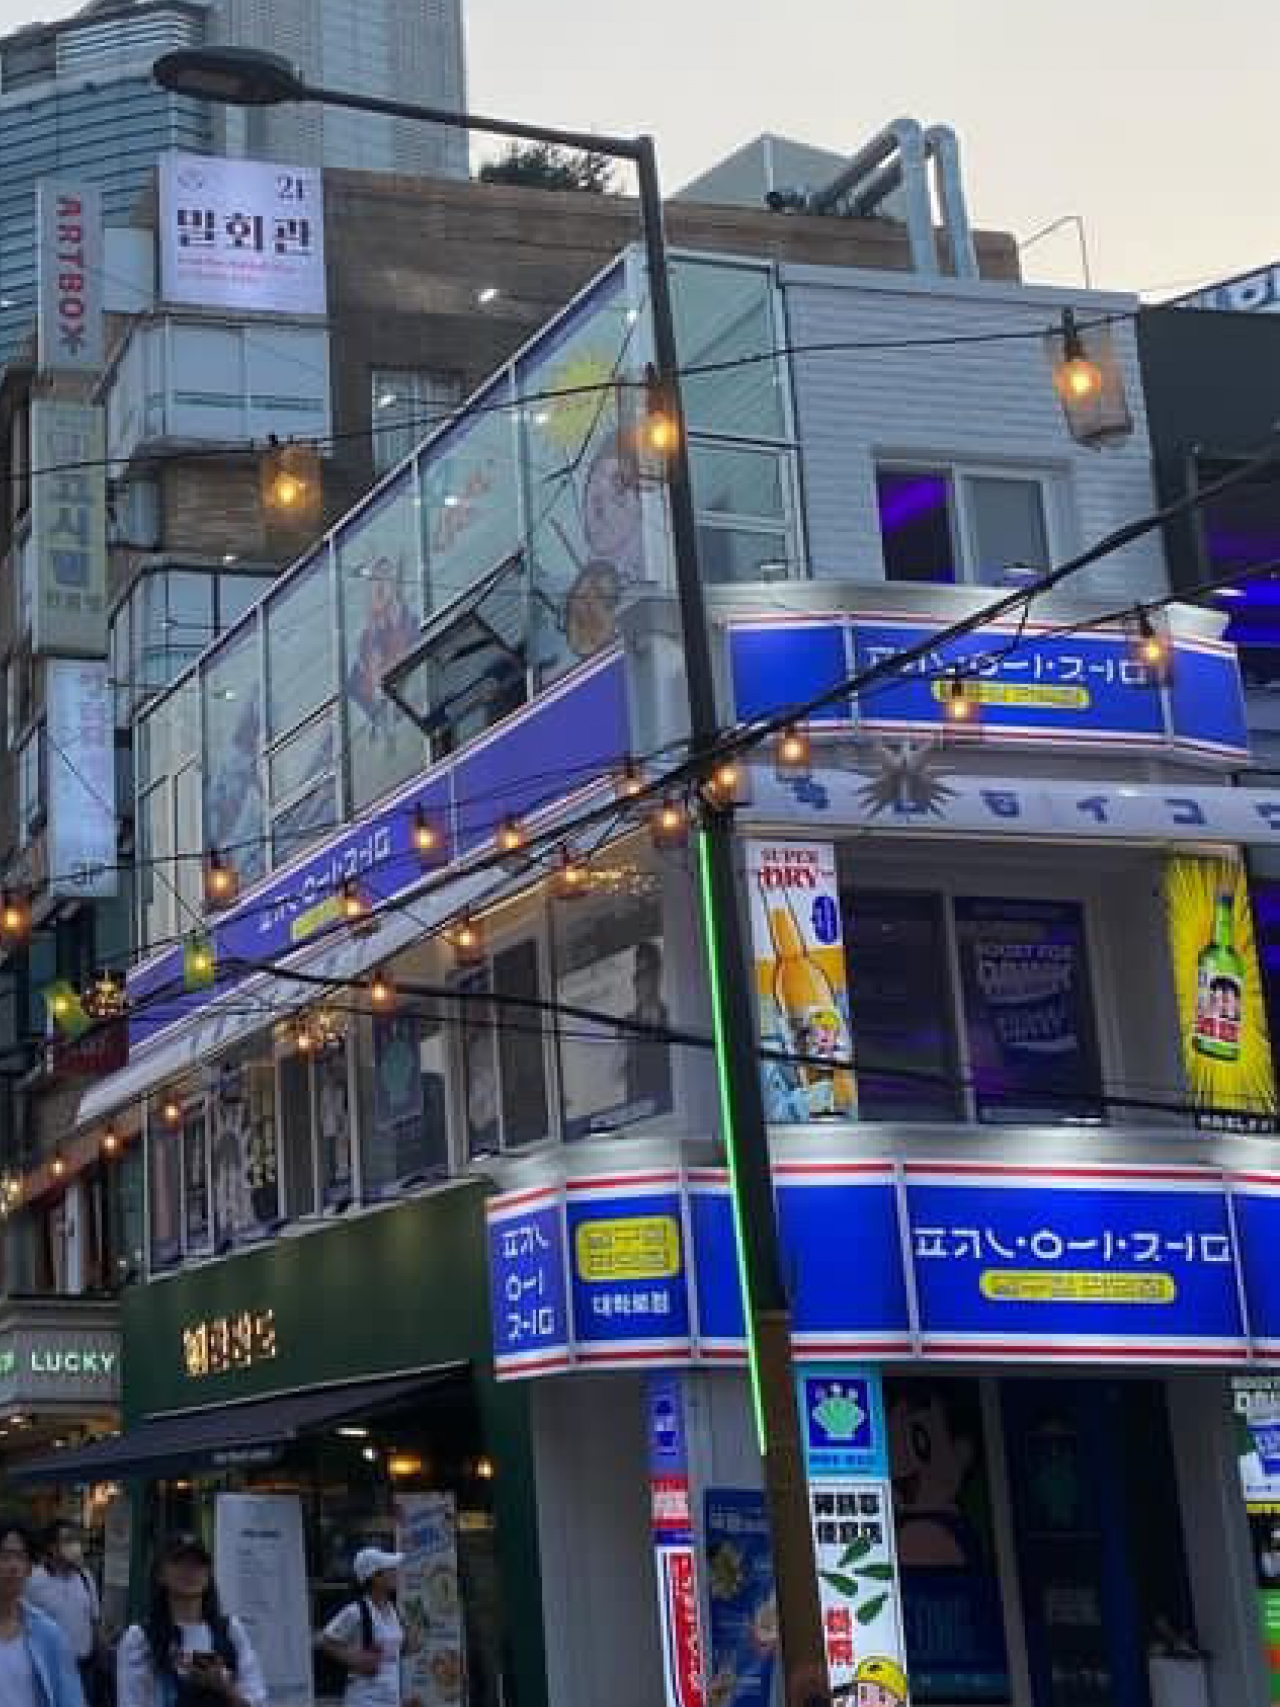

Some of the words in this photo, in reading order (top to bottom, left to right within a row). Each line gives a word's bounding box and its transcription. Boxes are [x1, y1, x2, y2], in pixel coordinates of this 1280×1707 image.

[56, 194, 85, 353] ARTBOX
[761, 848, 818, 864] SUPER
[30, 1351, 115, 1372] LUCKY
